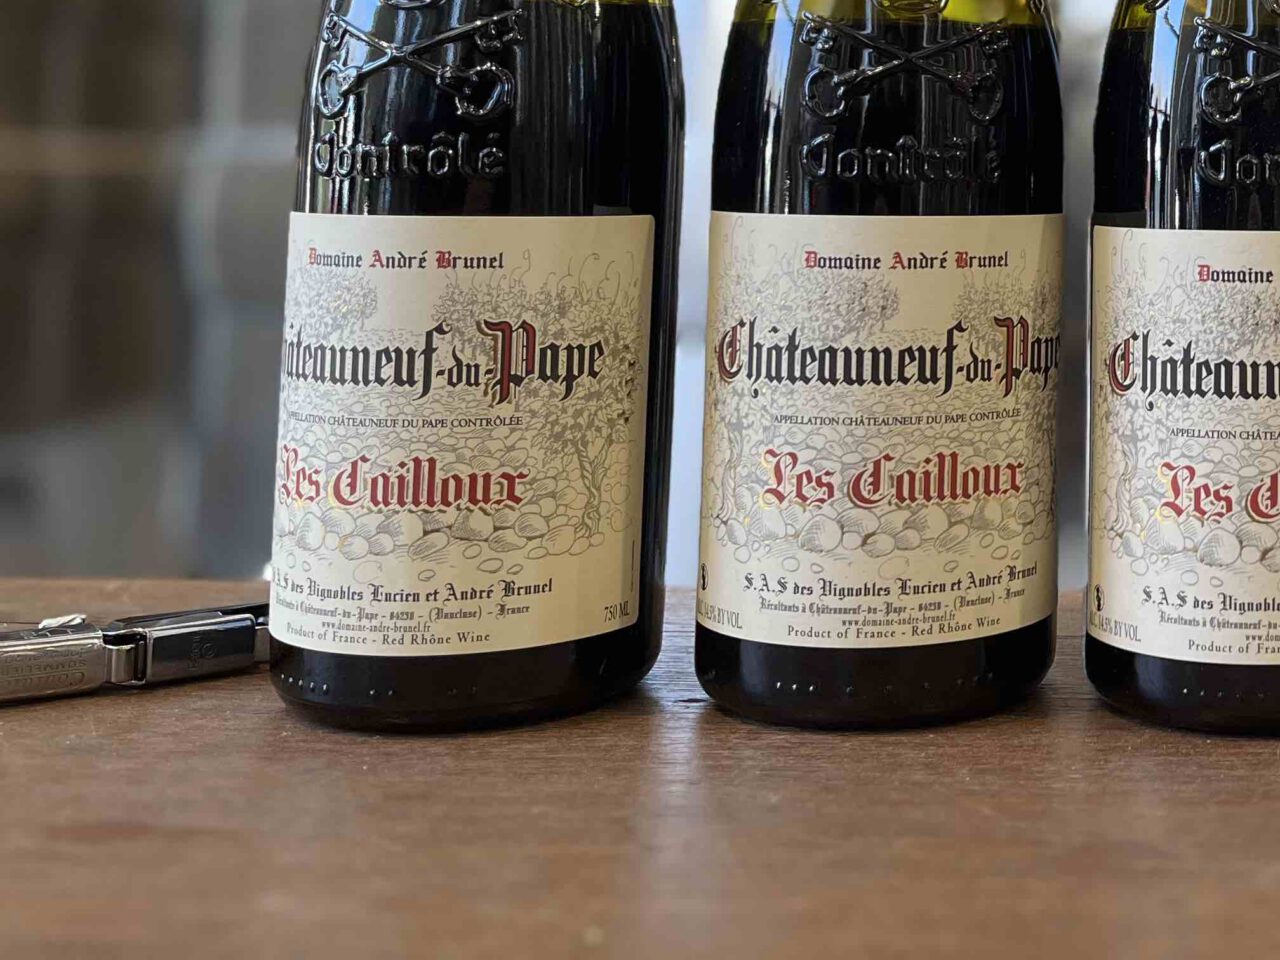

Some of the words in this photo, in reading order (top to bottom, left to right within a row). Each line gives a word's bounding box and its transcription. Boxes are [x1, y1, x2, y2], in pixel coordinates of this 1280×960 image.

[308, 247, 363, 268] Domaine
[369, 249, 427, 269] André
[436, 250, 504, 270] Brunel
[804, 250, 881, 270] Domaine
[889, 250, 948, 269] André
[955, 251, 1008, 269] Brunel
[1197, 264, 1273, 283] Domaine
[284, 318, 606, 407] âteauneuf-du-Pape
[327, 414, 399, 428] CHÂTEAUNEUF
[401, 418, 419, 429] DU
[422, 418, 448, 428] PAPE
[451, 414, 523, 428] CONTRÔLÉE
[774, 414, 840, 426] APPELLATION
[842, 414, 924, 427] CHÂTEAUNEUF
[926, 415, 943, 424] DU
[944, 413, 967, 423] PAPE
[968, 407, 1022, 421] CONTRÔLÉE
[1170, 427, 1237, 439] APPELLATION
[281, 443, 321, 503] Les
[329, 454, 532, 509] Cailloux
[763, 448, 834, 503] Les
[850, 451, 1024, 506] Cailloux
[1160, 460, 1233, 519] Les
[290, 580, 304, 594] des
[306, 577, 363, 601] Vignobles
[368, 583, 420, 606] Lucien
[425, 588, 440, 601] et
[443, 583, 494, 605] André
[497, 578, 552, 602] Brunel
[793, 582, 813, 596] des
[818, 578, 891, 601] Vignobles
[895, 578, 946, 600] Lucien
[951, 579, 962, 591] et
[963, 570, 1003, 595] André
[1006, 560, 1038, 585] Brunel
[604, 604, 617, 622] 750
[1193, 596, 1214, 610] des
[286, 622, 314, 639] Product
[318, 630, 328, 640] of
[333, 631, 367, 644] France
[382, 633, 405, 645] Red
[411, 633, 451, 645] Rhône
[457, 631, 490, 643] Wine
[787, 625, 831, 638] Product
[837, 627, 850, 639] of
[856, 628, 896, 639] France
[911, 625, 933, 637] Red
[938, 621, 972, 634] Rhône
[976, 616, 1001, 629] Wine
[1188, 639, 1232, 653] Product
[1238, 641, 1250, 654] of
